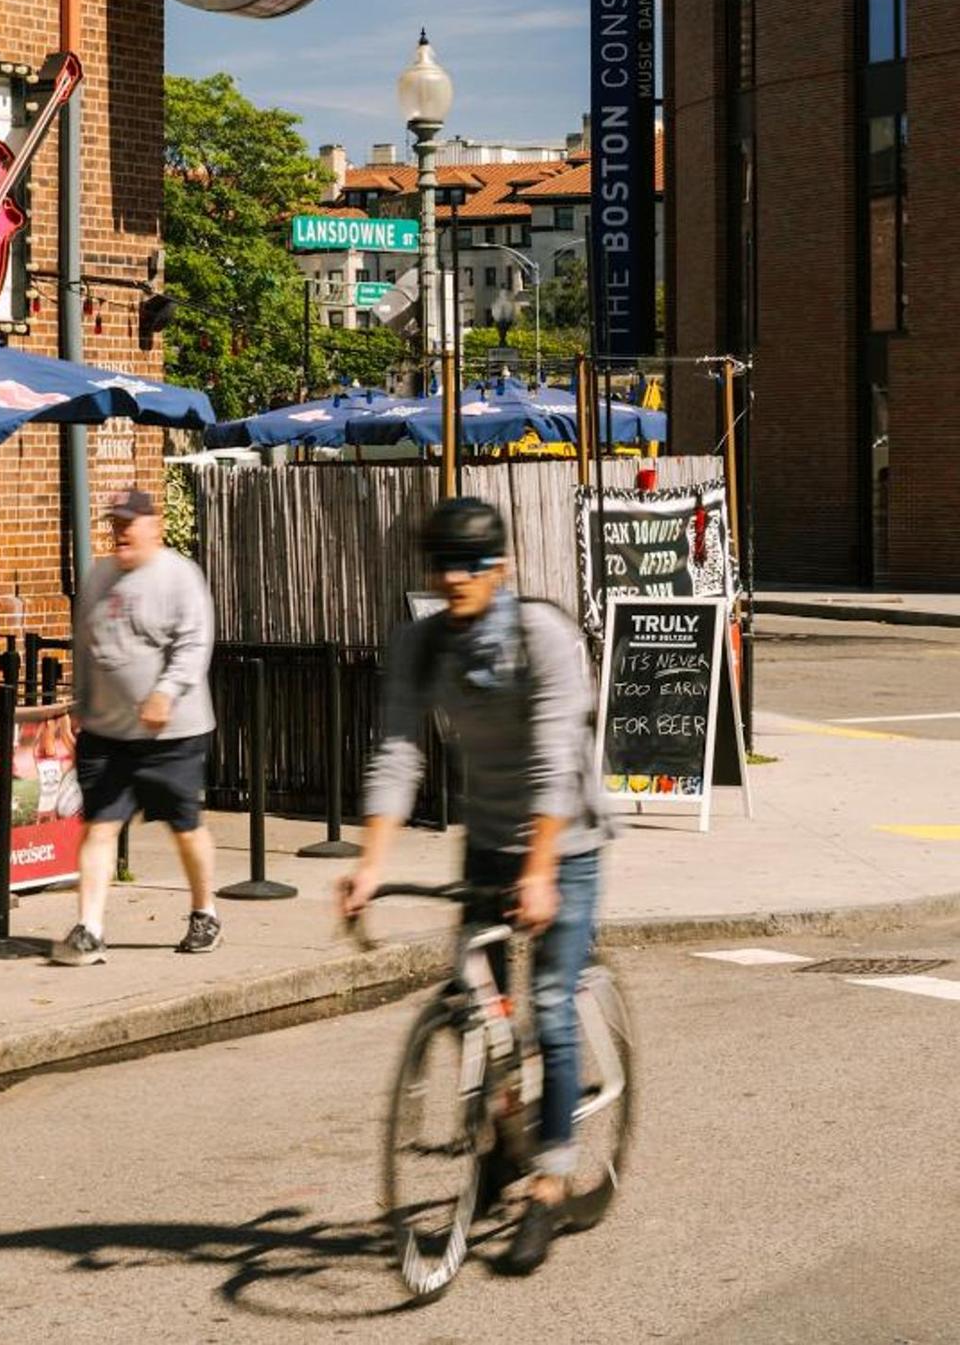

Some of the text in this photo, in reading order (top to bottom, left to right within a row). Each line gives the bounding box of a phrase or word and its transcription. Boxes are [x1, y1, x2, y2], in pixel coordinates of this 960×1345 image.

[638, 42, 653, 97] MUSIC
[601, 105, 629, 252] BOSTON
[297, 219, 396, 246] LANSDOWNE
[639, 550, 678, 576] AFTER
[620, 652, 709, 675] IT'S NEVER
[615, 681, 708, 697] TOO EARLY
[613, 713, 706, 738] FOR BEER
